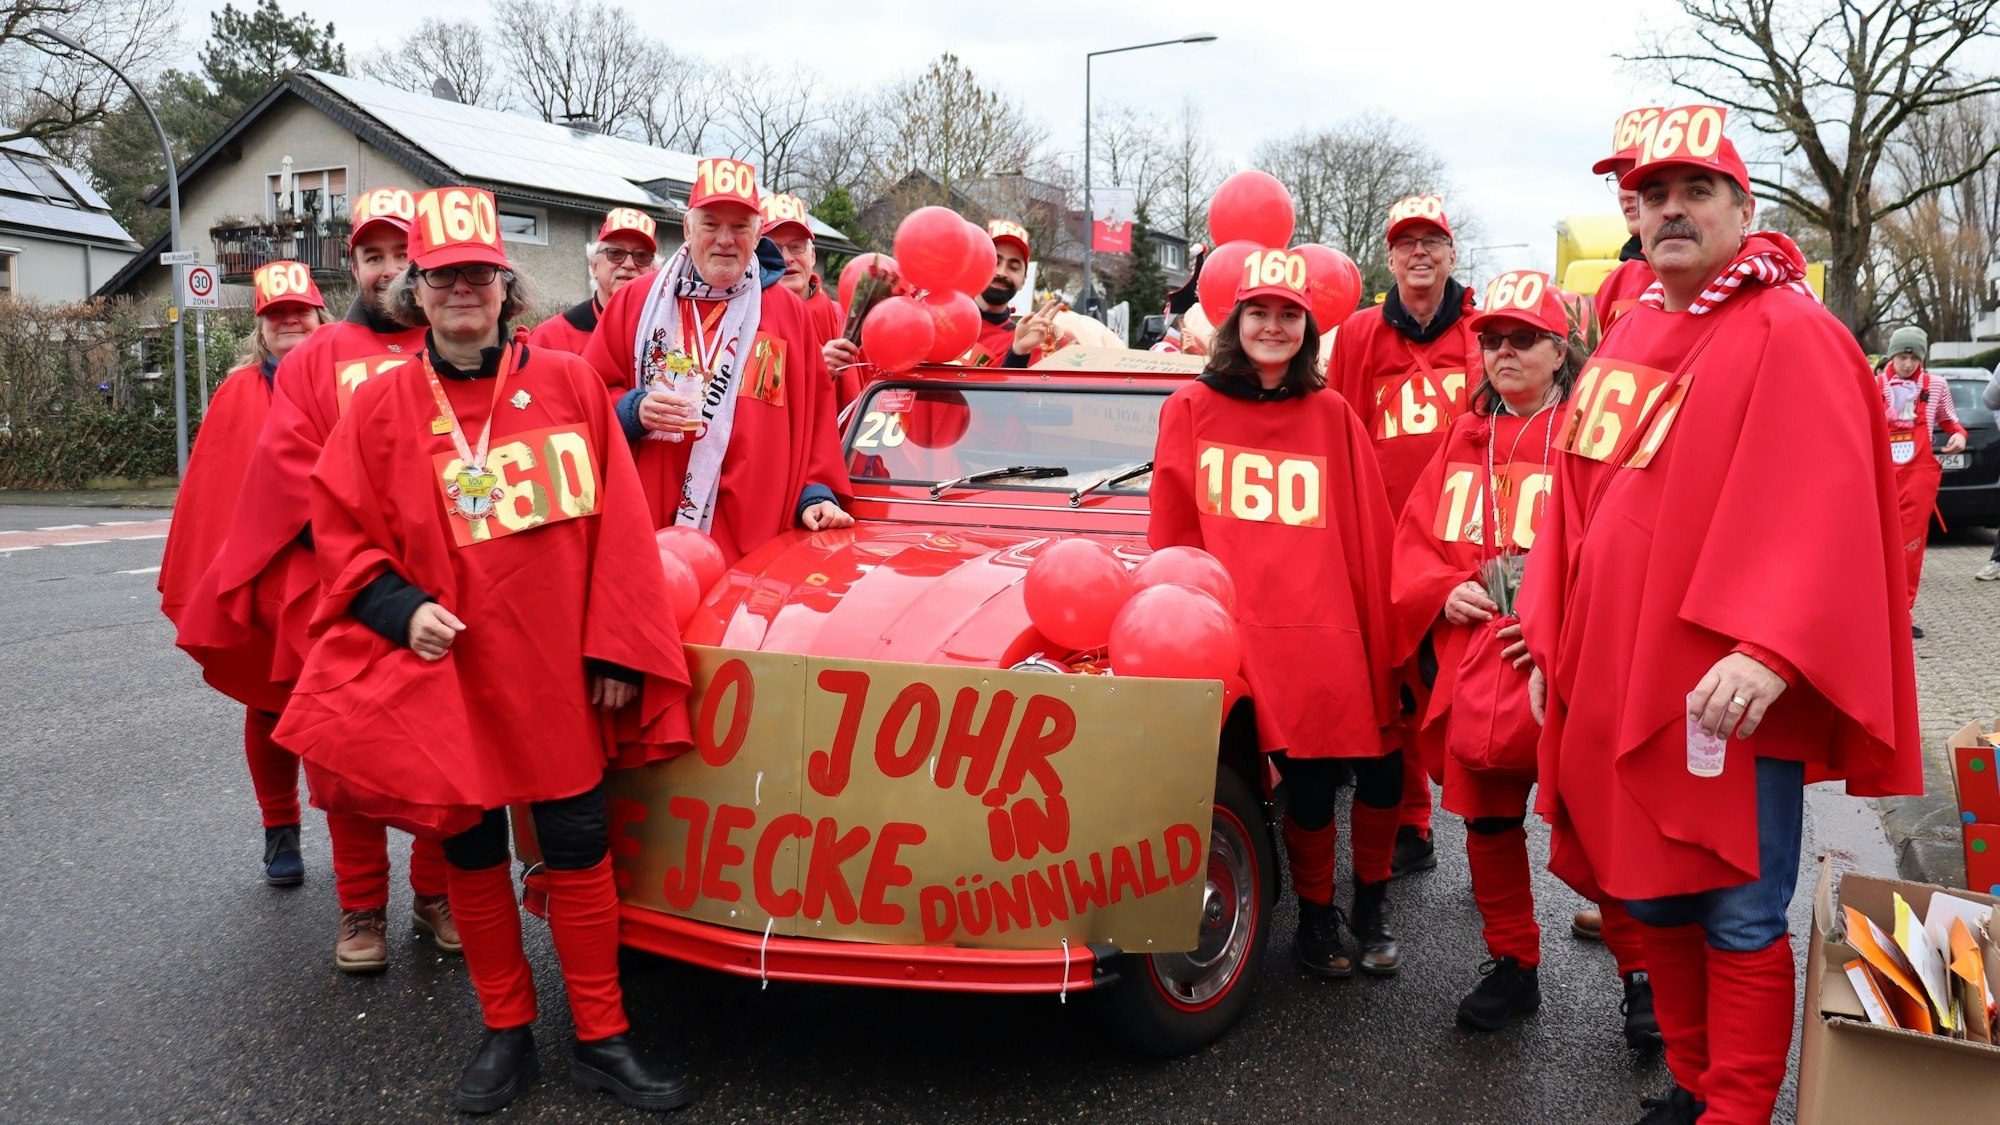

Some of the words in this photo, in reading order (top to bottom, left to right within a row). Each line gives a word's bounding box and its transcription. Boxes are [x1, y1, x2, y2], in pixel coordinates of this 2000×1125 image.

[1639, 107, 1722, 166] 160
[698, 159, 754, 198] 160
[356, 189, 415, 223] 160
[419, 190, 496, 246] 160
[609, 207, 655, 236] 160
[760, 192, 806, 223] 160
[1389, 197, 1441, 221] 160
[989, 220, 1028, 244] 160
[194, 275, 208, 289] 30
[255, 263, 308, 301] 160
[1244, 250, 1306, 290] 160
[1484, 273, 1543, 314] 160
[1200, 447, 1320, 526] 160
[807, 669, 1077, 797] JOHR
[663, 795, 927, 926] JECKE
[919, 823, 1202, 943] DÜNNWALD
